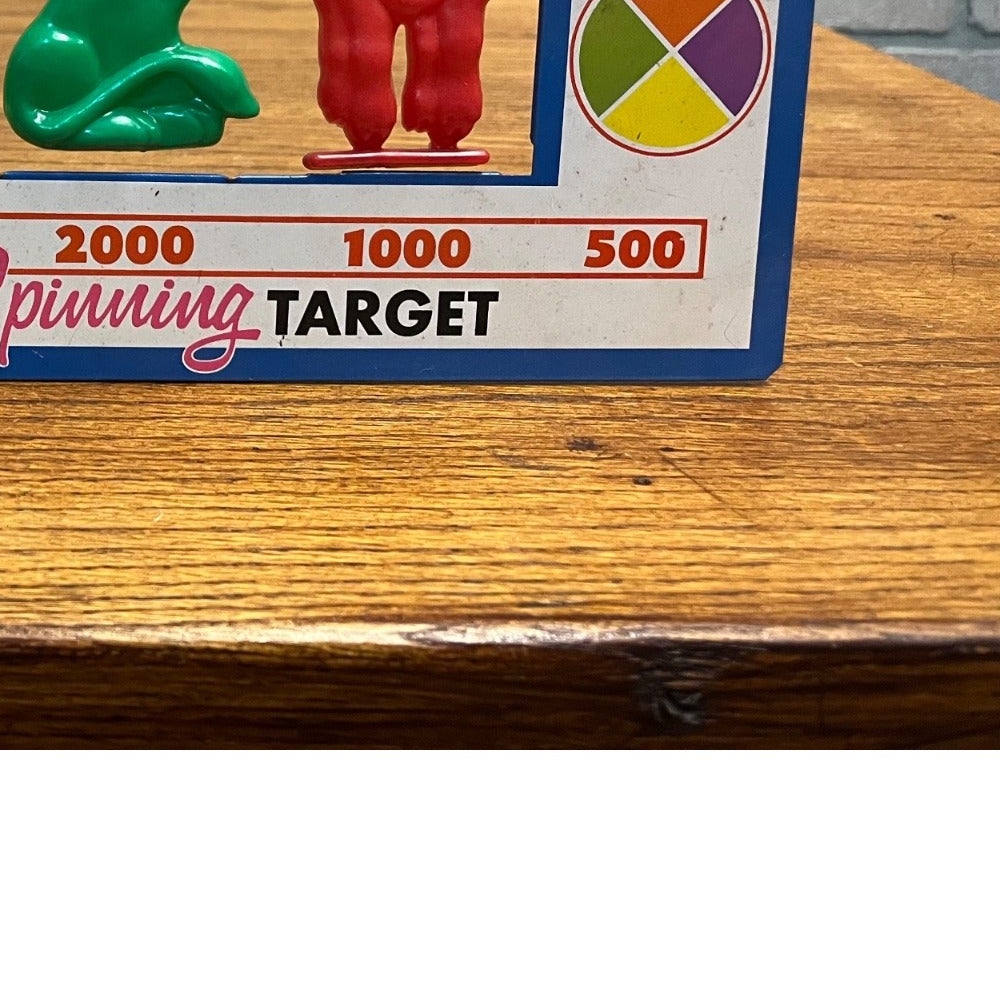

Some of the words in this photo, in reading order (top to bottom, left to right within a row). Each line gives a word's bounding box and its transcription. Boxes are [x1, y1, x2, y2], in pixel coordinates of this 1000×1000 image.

[56, 223, 194, 265] 2000
[344, 228, 471, 269] 1000
[584, 229, 685, 269] 500
[267, 289, 499, 338] TARGET
